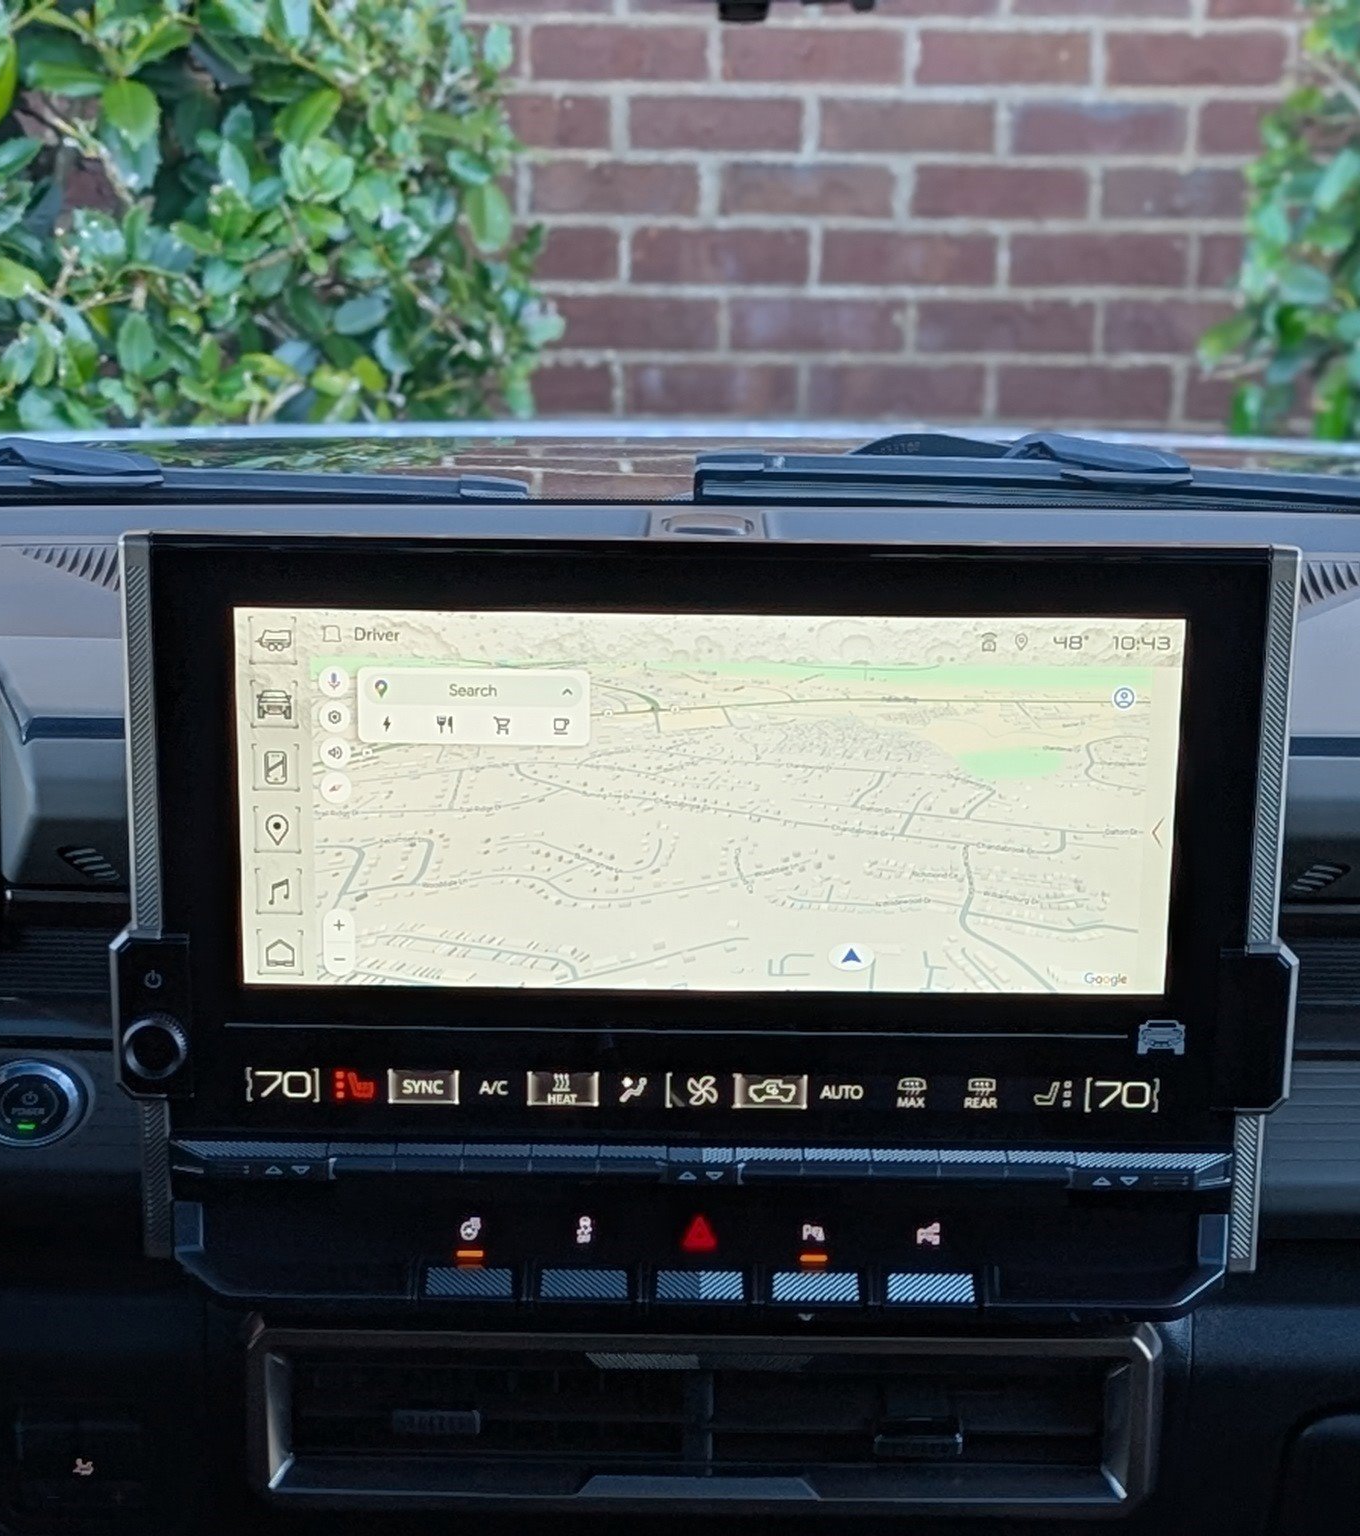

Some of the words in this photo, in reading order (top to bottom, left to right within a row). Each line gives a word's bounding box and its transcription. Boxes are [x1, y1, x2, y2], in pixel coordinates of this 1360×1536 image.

[353, 627, 401, 643] Driver
[1113, 635, 1171, 651] 10:43
[449, 683, 498, 698] Search
[1084, 971, 1128, 987] Google
[254, 1071, 312, 1099] 70
[402, 1079, 444, 1096] SYNC
[479, 1079, 509, 1096] A/C
[820, 1084, 864, 1101] AUTO
[547, 1093, 577, 1105] HEAT
[896, 1096, 925, 1109] MAX
[963, 1096, 998, 1109] REAR
[1095, 1081, 1153, 1109] 70
